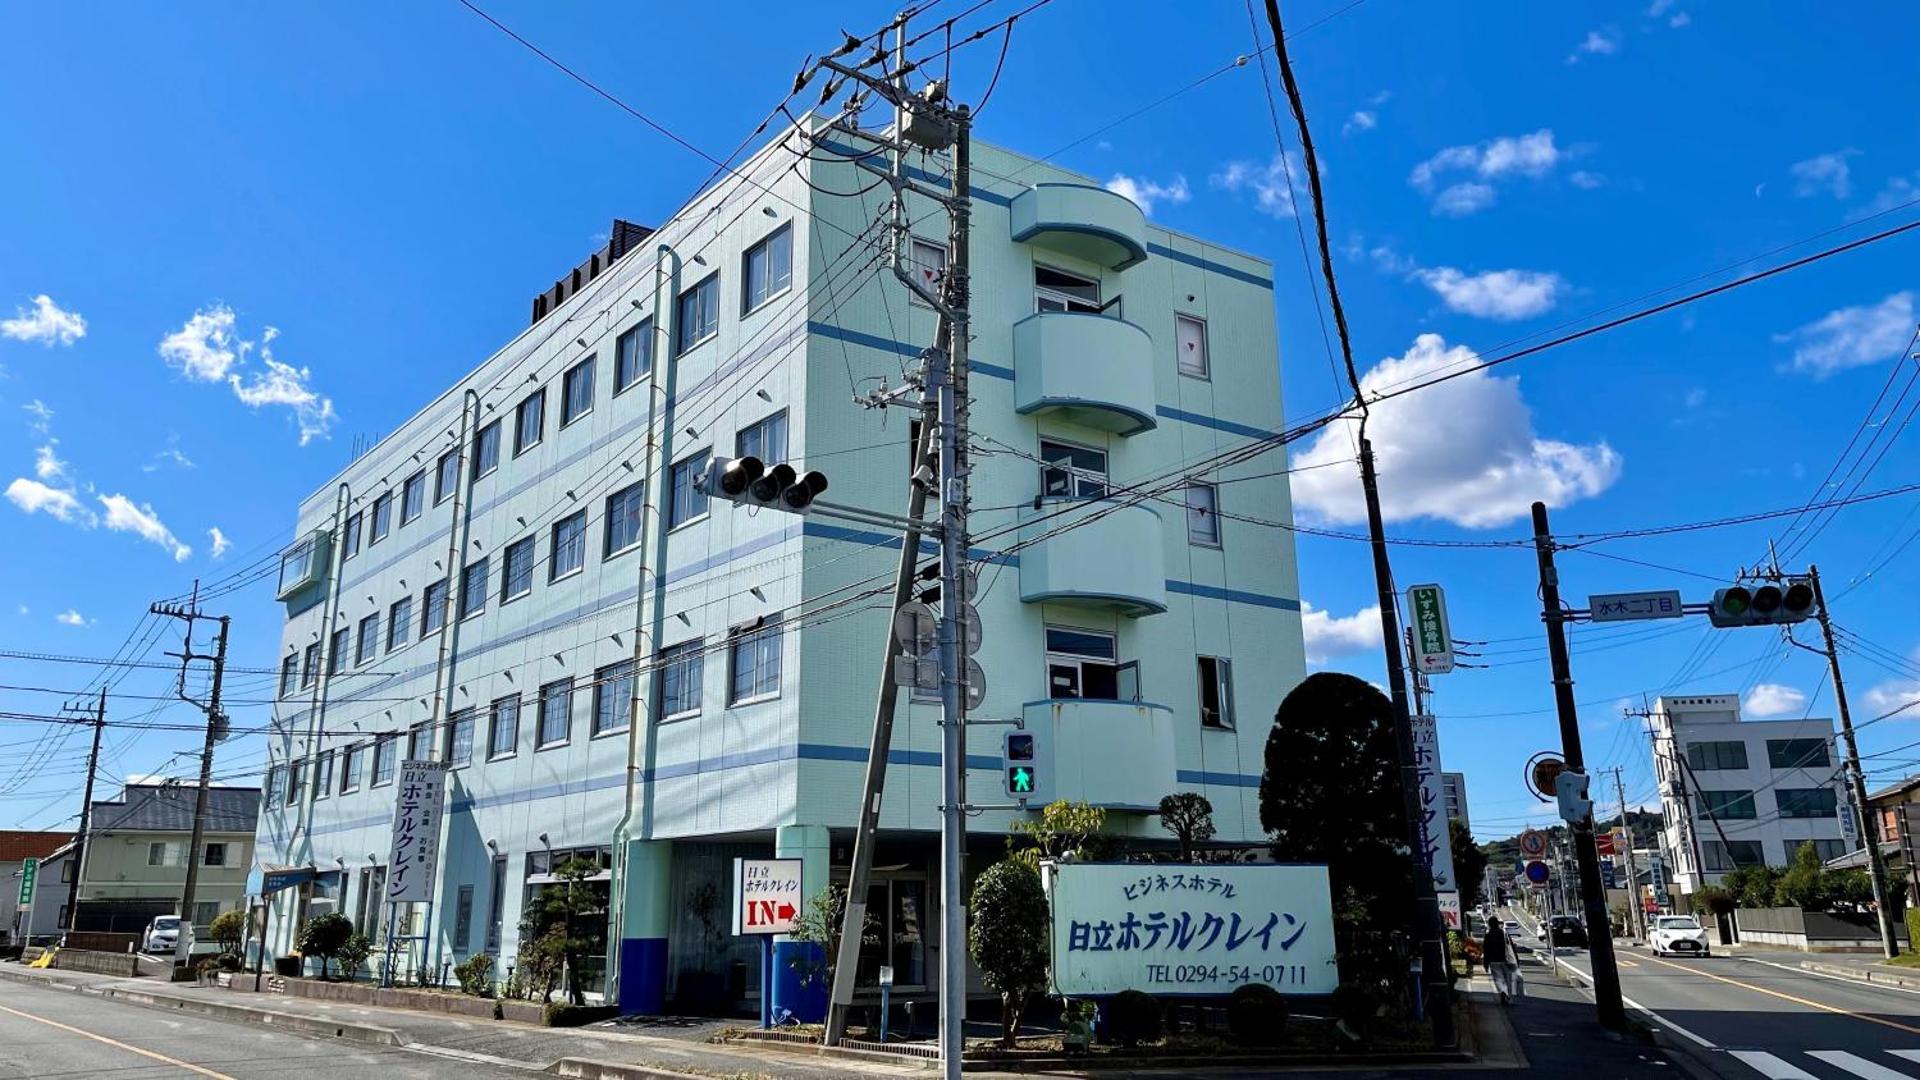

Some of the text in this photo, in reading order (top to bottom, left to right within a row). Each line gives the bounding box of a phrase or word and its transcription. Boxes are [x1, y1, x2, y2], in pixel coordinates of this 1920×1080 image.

[1599, 597, 1673, 616] 水木二丁目
[1418, 590, 1441, 653] いずみ接骨院
[390, 784, 421, 897] ホテルクレイン
[748, 866, 769, 878] 日立
[746, 879, 799, 893] ホテルクレイン
[1123, 874, 1238, 901] ビジネスホテル
[747, 900, 777, 926] IN
[1068, 911, 1307, 952] 日立ホテルクレイン
